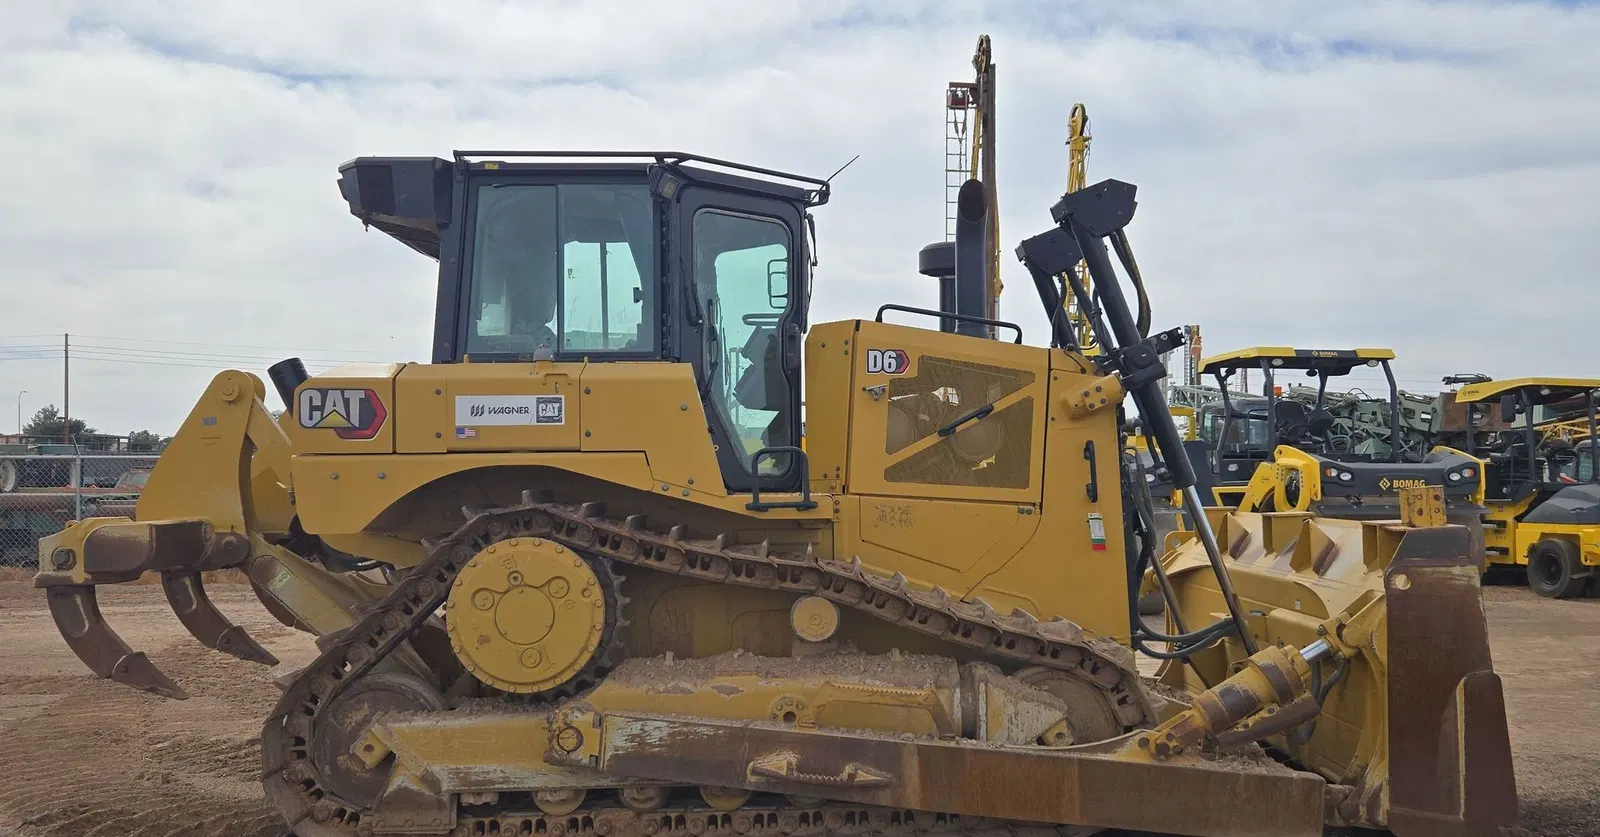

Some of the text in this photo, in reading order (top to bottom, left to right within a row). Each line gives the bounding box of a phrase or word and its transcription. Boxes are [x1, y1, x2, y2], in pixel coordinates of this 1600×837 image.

[868, 350, 897, 373] D6
[300, 389, 365, 428] CAT
[488, 402, 560, 417] WAGNER CAT
[1392, 479, 1426, 488] BOMAG
